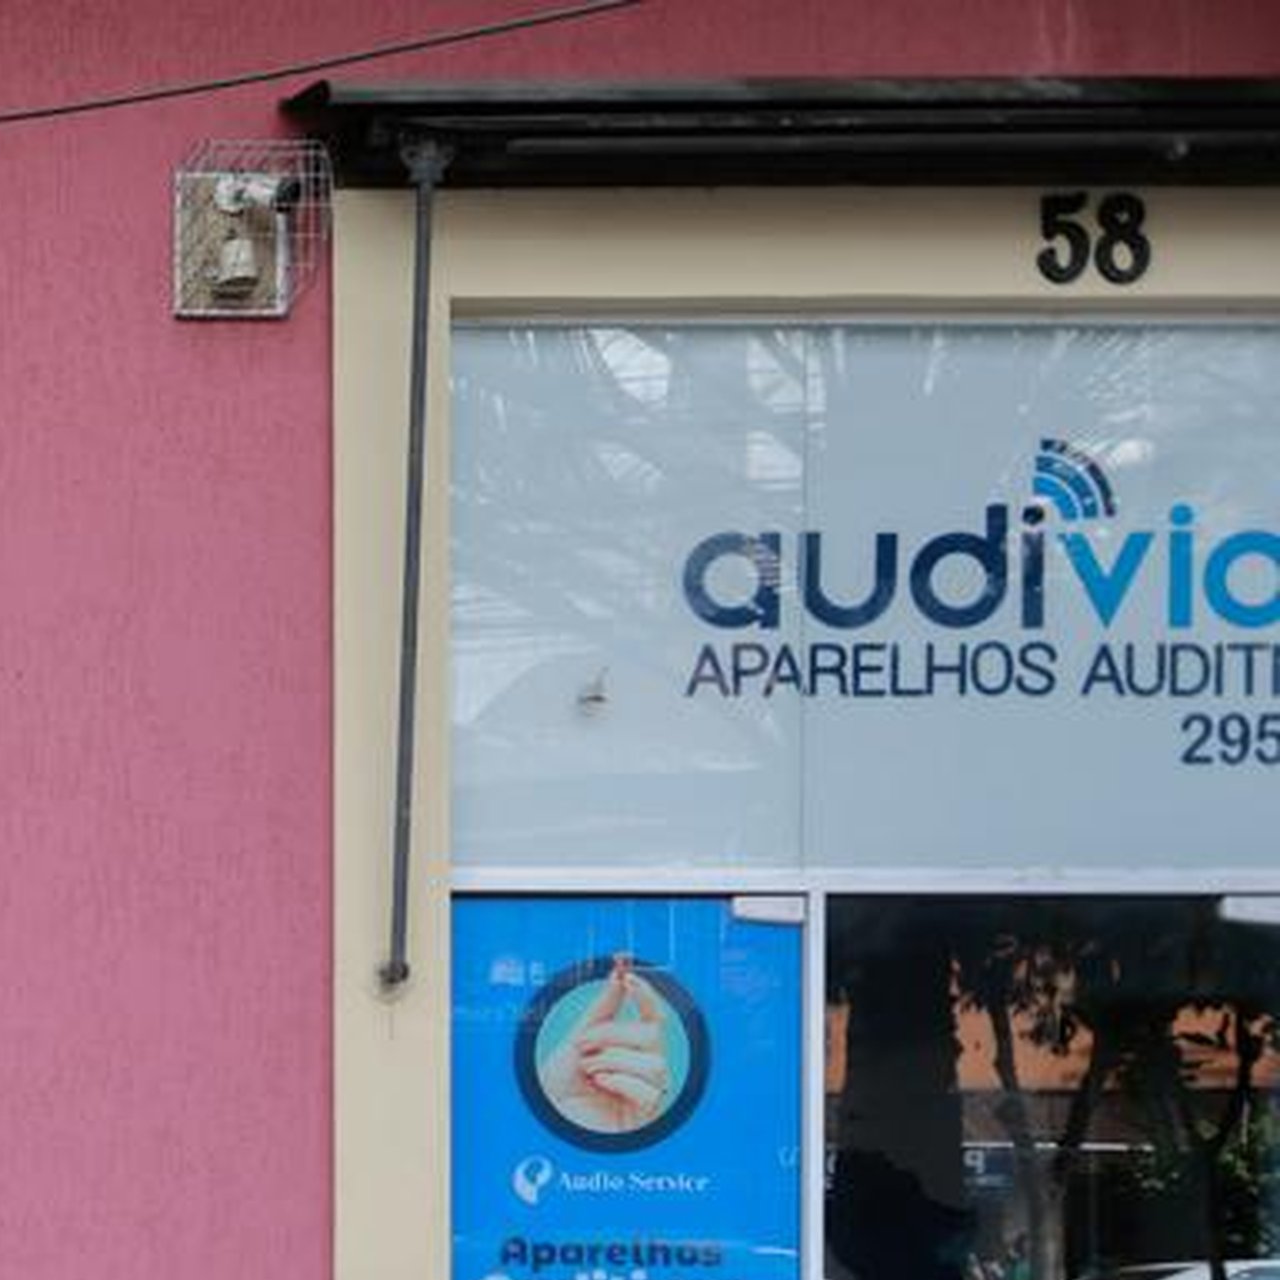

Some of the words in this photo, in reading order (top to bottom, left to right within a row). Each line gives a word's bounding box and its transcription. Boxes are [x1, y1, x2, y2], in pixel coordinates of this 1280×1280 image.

[1037, 191, 1151, 285] 58
[686, 641, 1057, 699] APARELHOS
[559, 1170, 624, 1192] Audio
[627, 1170, 709, 1192] Service
